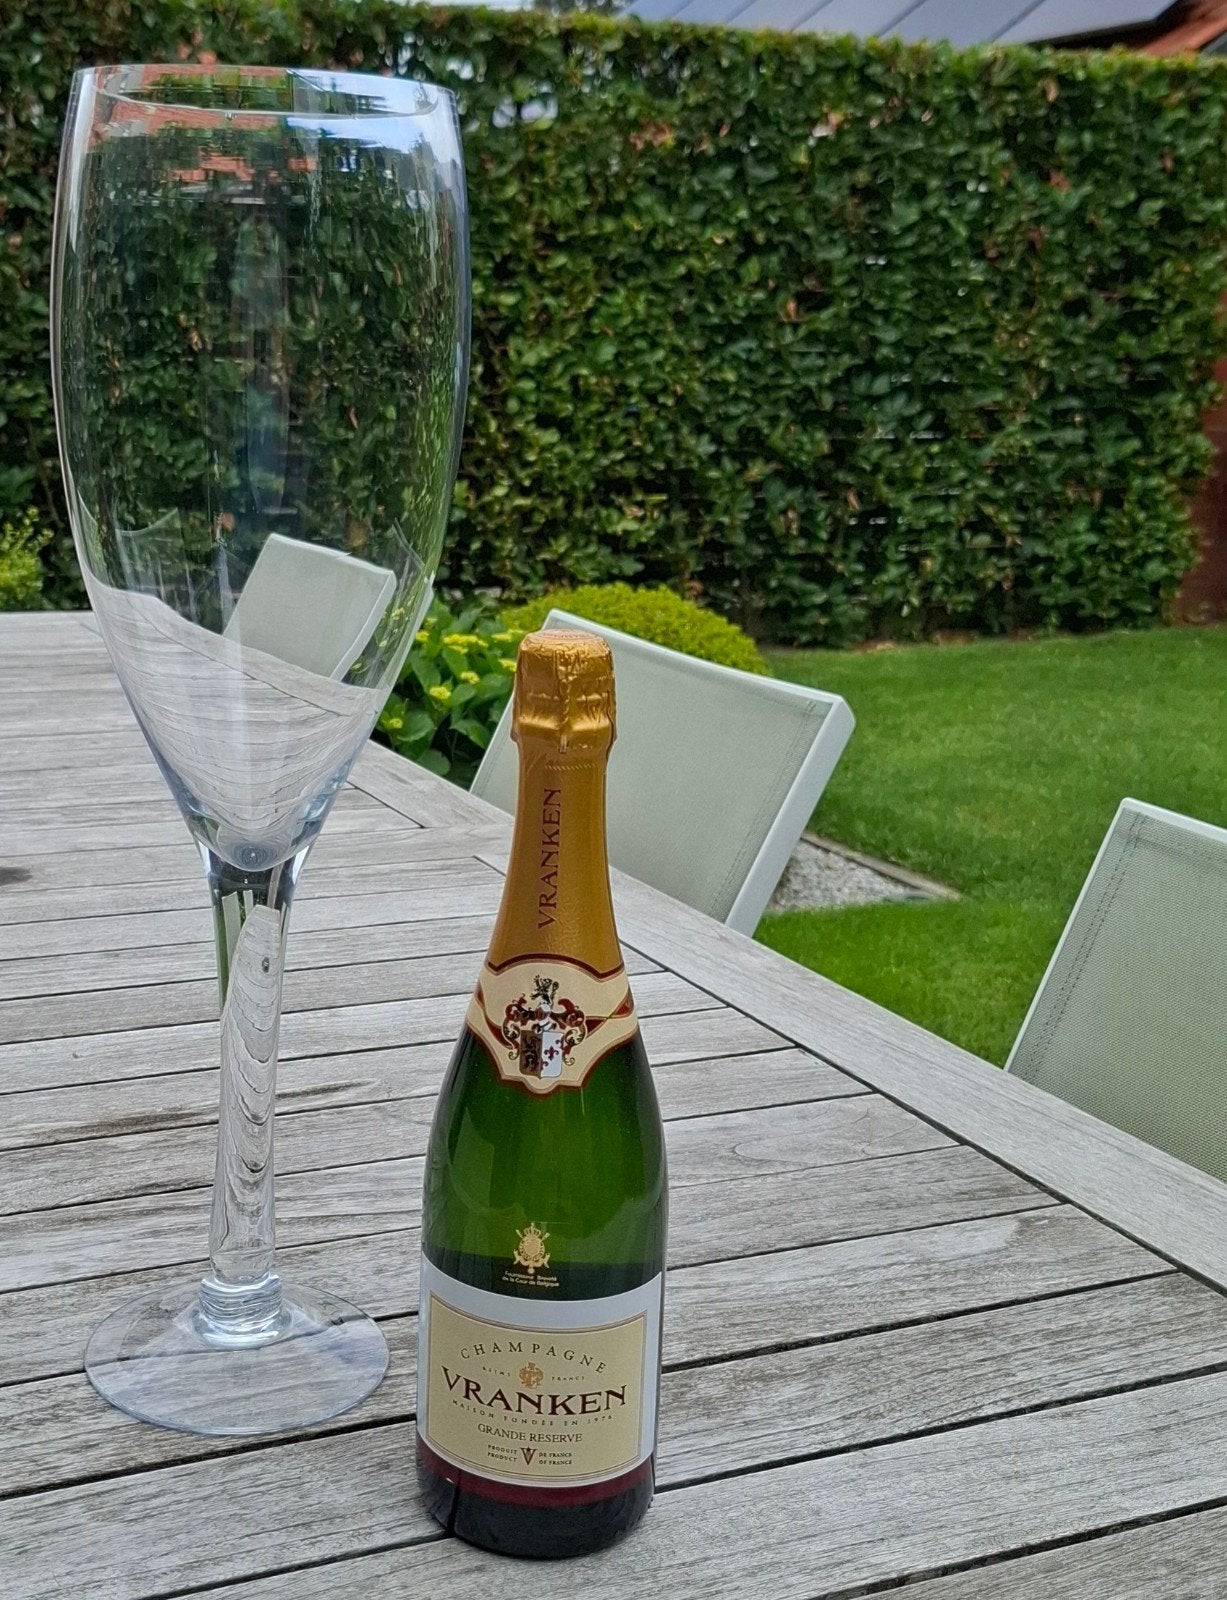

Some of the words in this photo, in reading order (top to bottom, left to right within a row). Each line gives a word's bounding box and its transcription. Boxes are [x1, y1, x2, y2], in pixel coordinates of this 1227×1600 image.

[538, 788, 562, 929] VRANKEN
[460, 1341, 607, 1374] CHAMPAGNE
[441, 1365, 627, 1416] VRANKEN
[452, 1399, 494, 1419] MAISON
[477, 1423, 527, 1441] GRANDE
[529, 1433, 583, 1443] RESERVE
[487, 1444, 517, 1455] PRODUIT
[487, 1452, 517, 1462] PRODUCT
